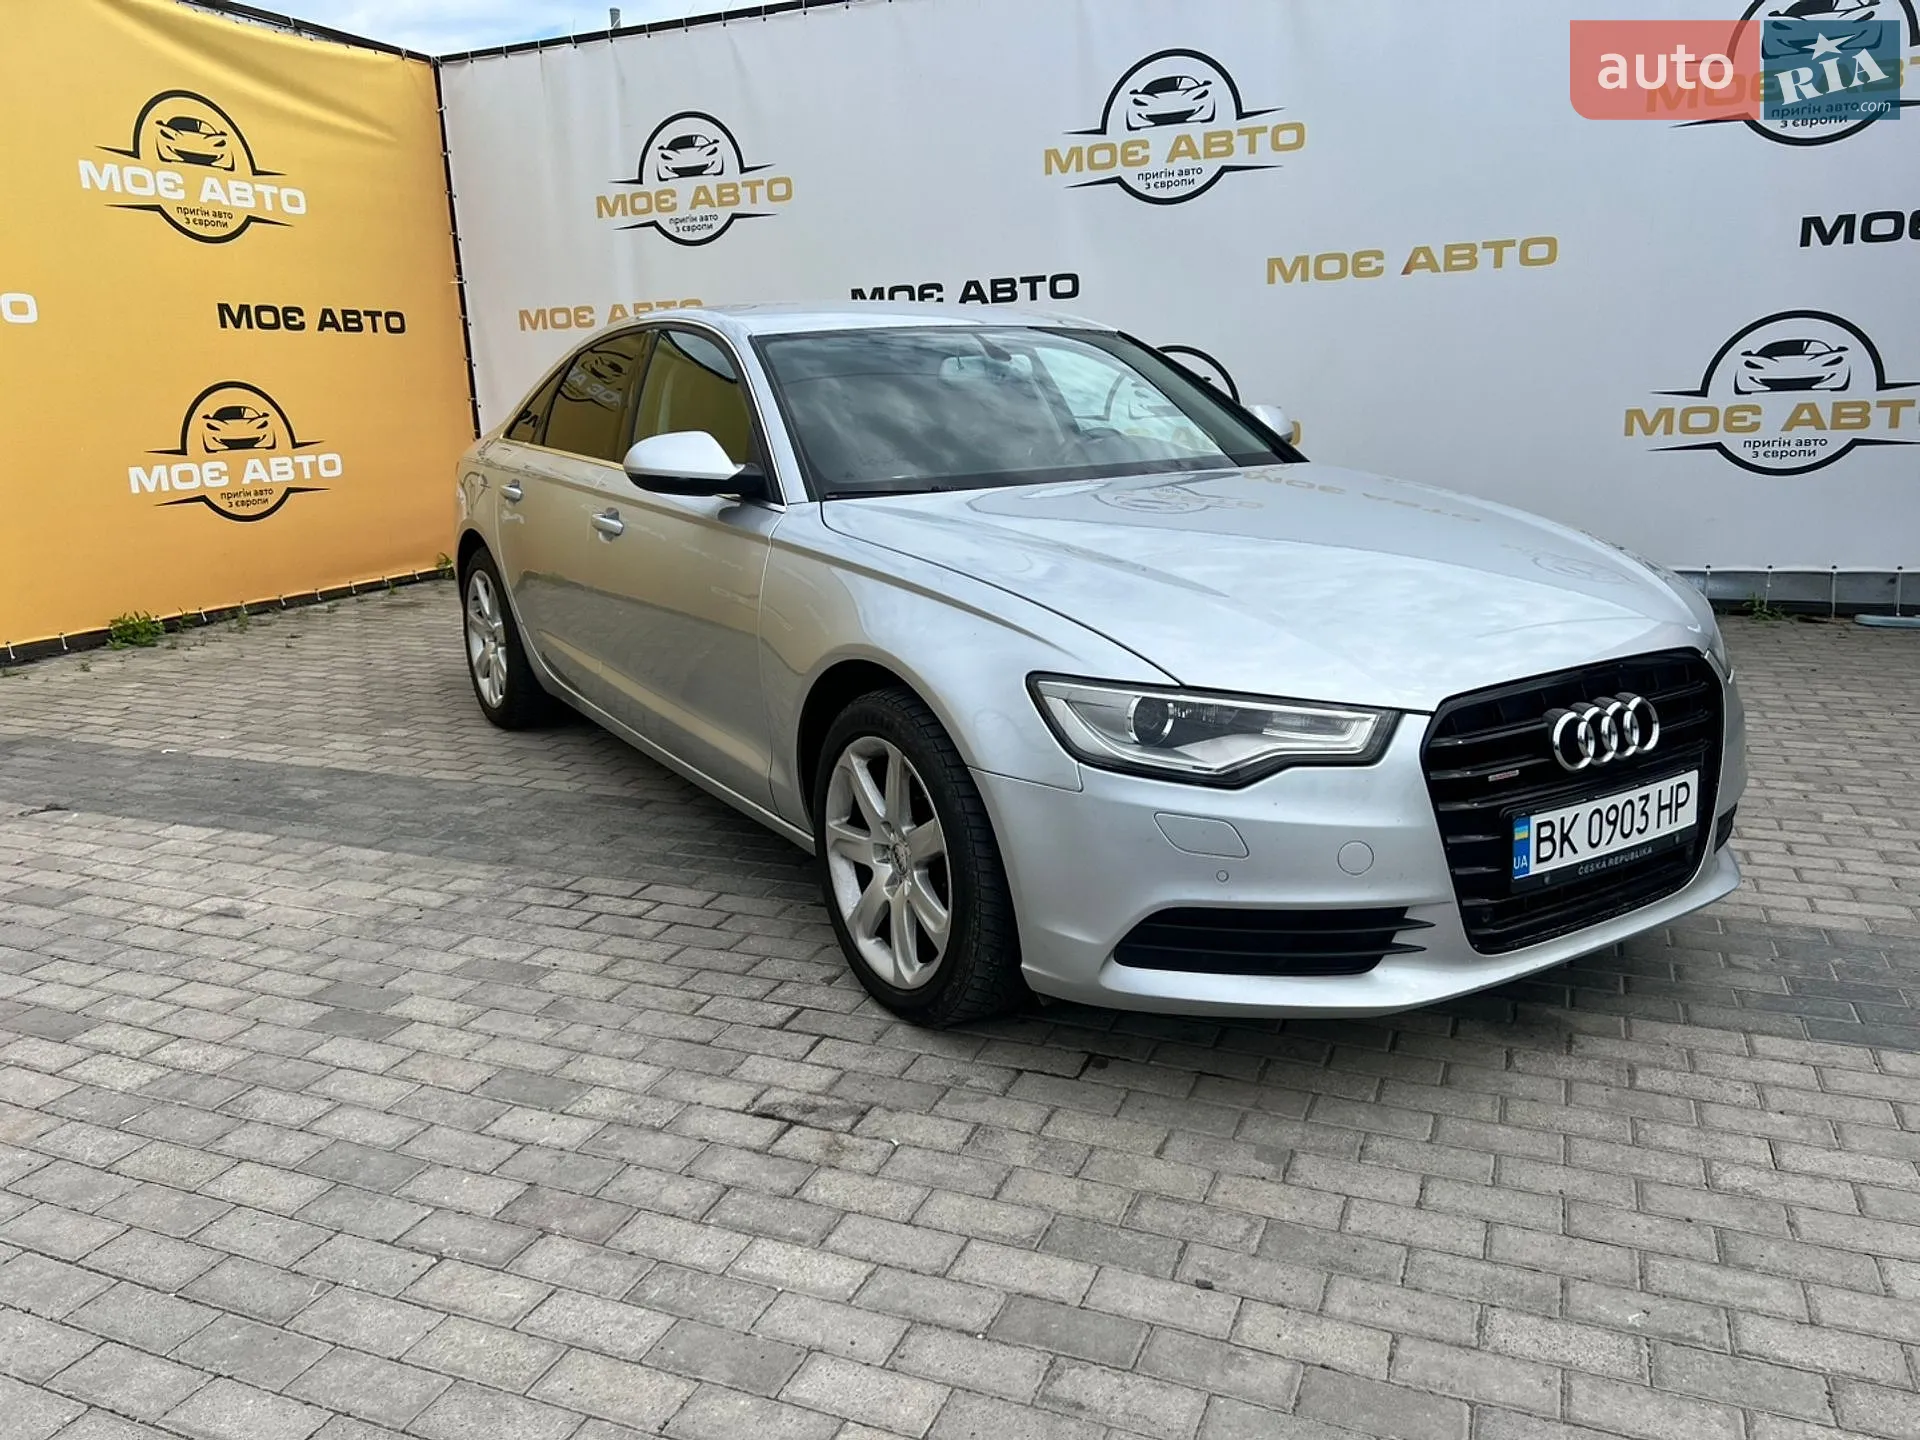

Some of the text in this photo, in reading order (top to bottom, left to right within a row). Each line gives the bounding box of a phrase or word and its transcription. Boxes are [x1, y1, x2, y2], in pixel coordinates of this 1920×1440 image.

[1043, 122, 1306, 176] МОЄ АВТО
[78, 159, 308, 215] МОЄ АВТО
[1137, 167, 1203, 181] пригін авто
[1153, 178, 1195, 190] європи
[176, 206, 234, 220] пригін авто
[595, 176, 793, 219] МОЄ АВТО
[1266, 236, 1558, 285] МОЄ АВТО
[958, 272, 1080, 305] АВТО
[216, 302, 407, 335] МОЄ АВТО
[518, 305, 595, 332] МОЄ
[1623, 399, 1920, 437] МОЄ АВТ
[1743, 437, 1828, 451] пригін авто
[1763, 448, 1817, 460] європи
[128, 452, 343, 495] МОЄ АВТО
[1536, 781, 1691, 865] BK 0903 HP
[1513, 855, 1528, 870] UA
